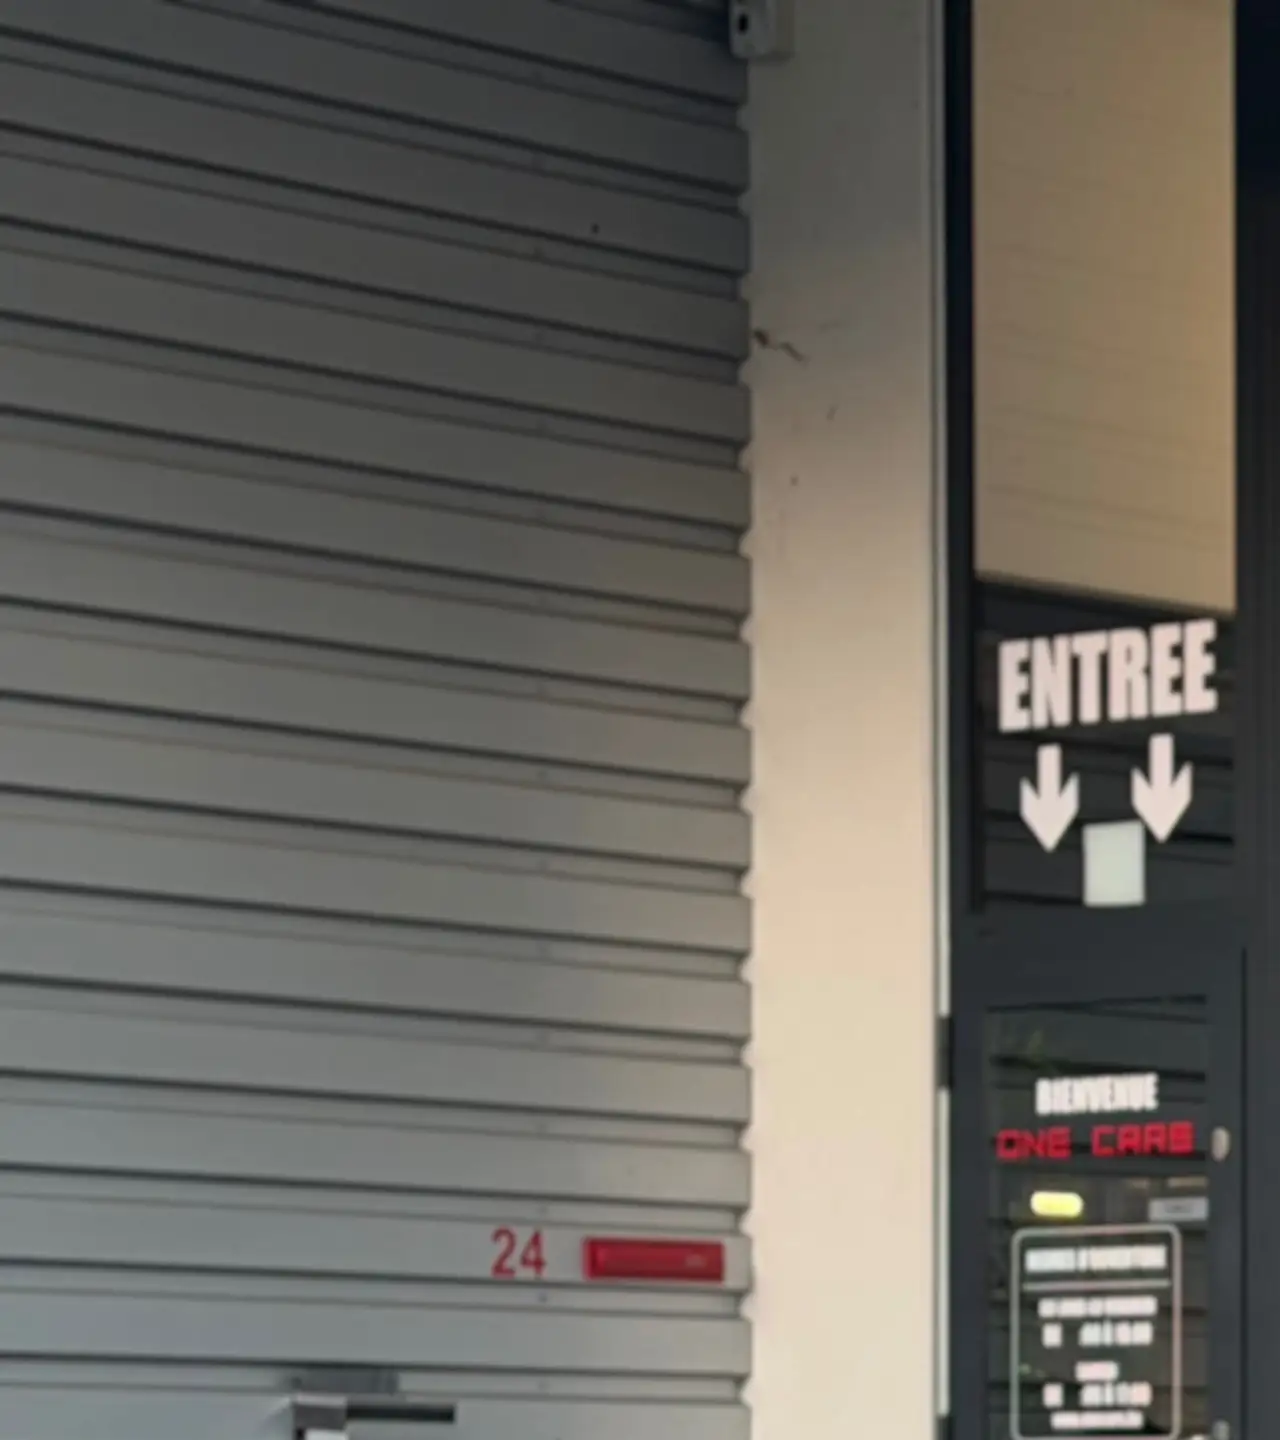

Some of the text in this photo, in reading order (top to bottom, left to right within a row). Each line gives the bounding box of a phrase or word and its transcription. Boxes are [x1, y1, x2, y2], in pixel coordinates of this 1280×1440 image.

[998, 618, 1217, 732] ENTREE
[996, 1121, 1194, 1160] ONE CARS
[490, 1226, 547, 1279] 24
